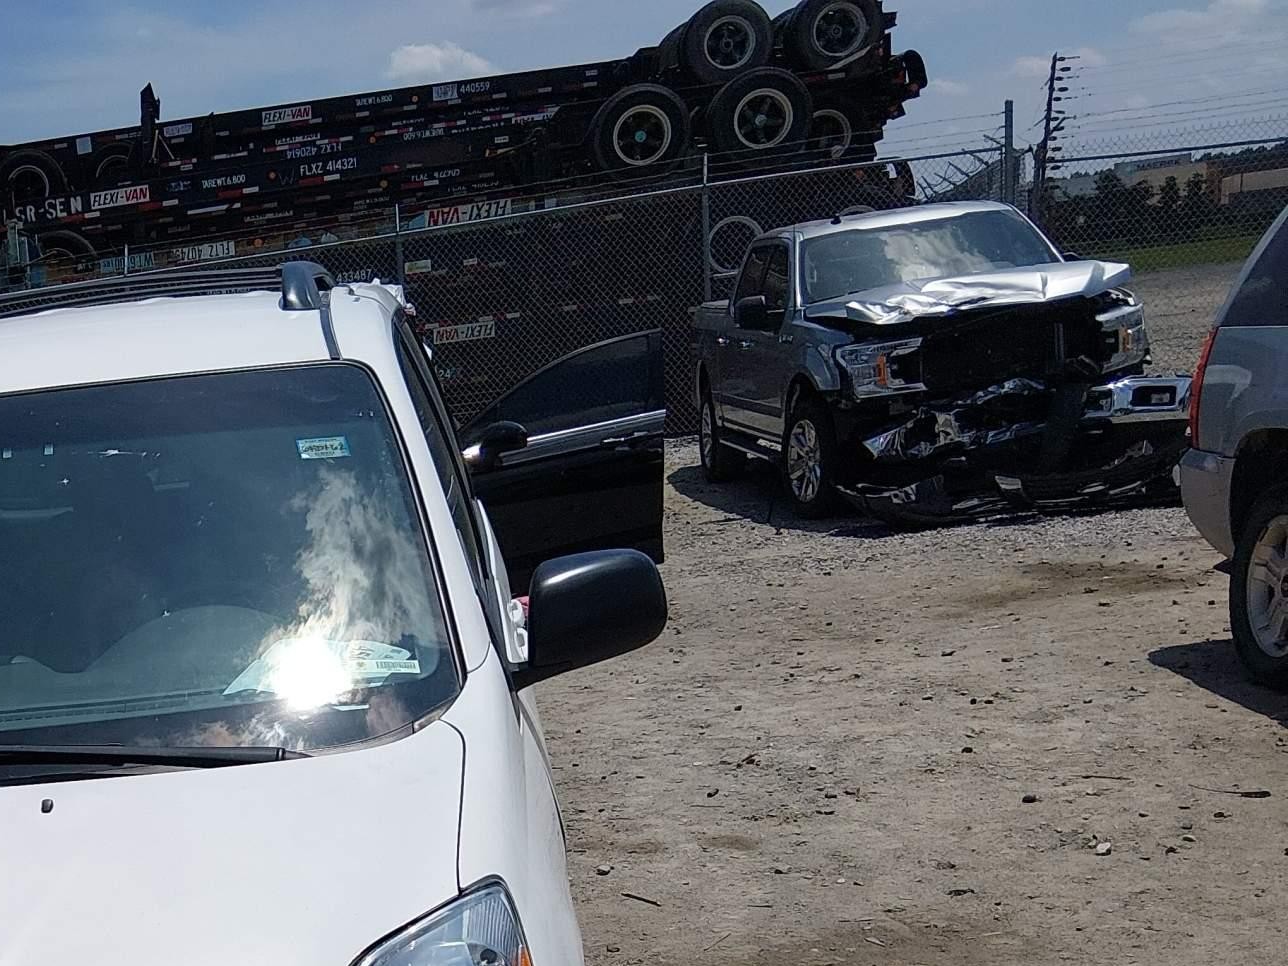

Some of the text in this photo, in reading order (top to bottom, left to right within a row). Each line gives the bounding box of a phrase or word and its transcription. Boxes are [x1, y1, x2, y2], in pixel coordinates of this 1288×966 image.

[263, 106, 311, 123] FLEXI-VAN
[299, 157, 358, 177] FLXZ 414321
[91, 186, 149, 209] FLEXI-VAN
[426, 199, 509, 228] FLEXI-VAN
[435, 323, 494, 343] FLEXI-VAN
